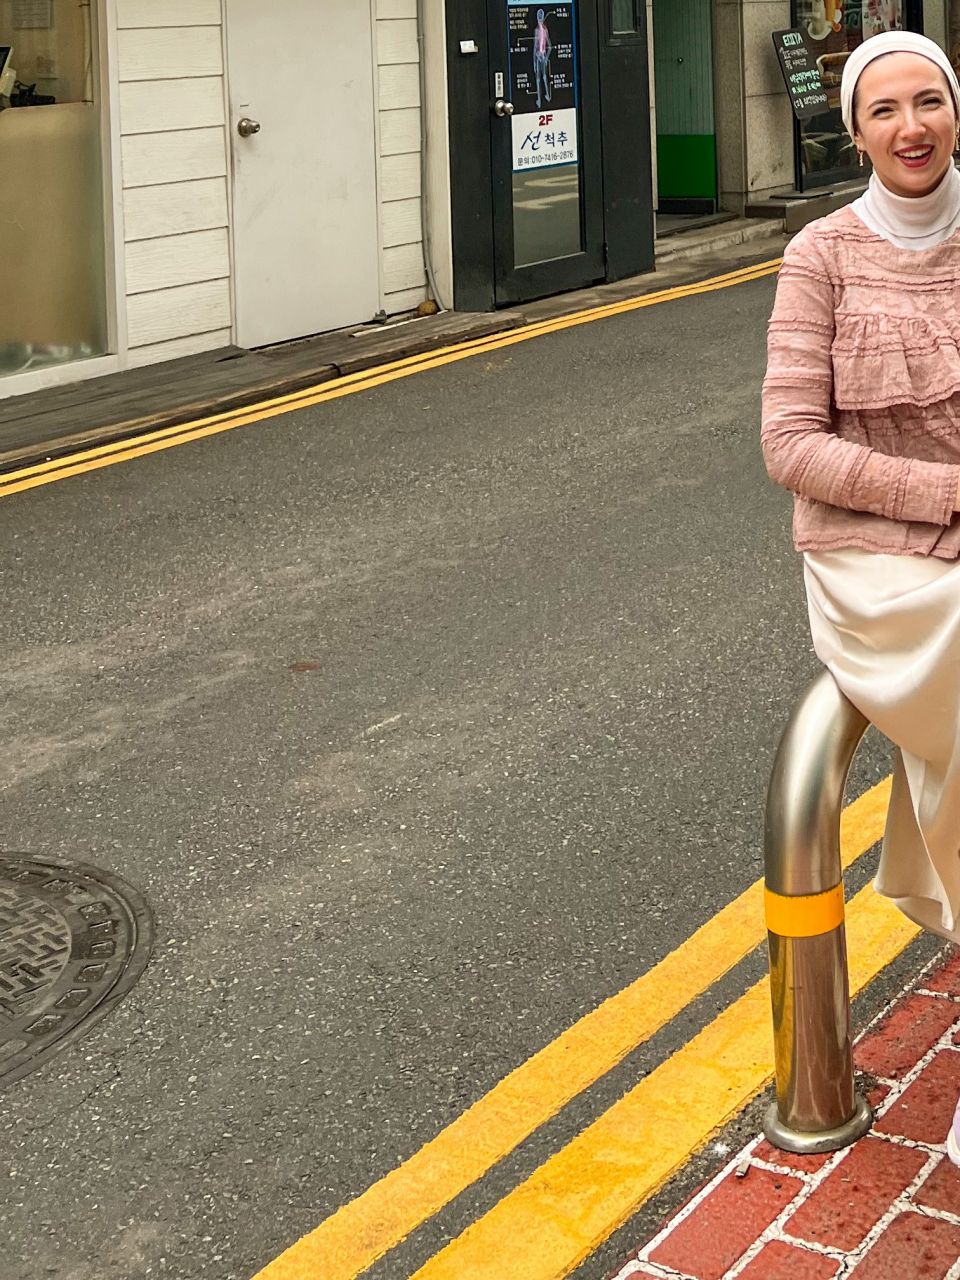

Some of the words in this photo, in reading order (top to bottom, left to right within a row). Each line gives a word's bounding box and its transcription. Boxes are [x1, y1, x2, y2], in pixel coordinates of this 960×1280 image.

[782, 32, 803, 46] EDIYA
[538, 114, 553, 126] 2F
[544, 130, 568, 148] 척추
